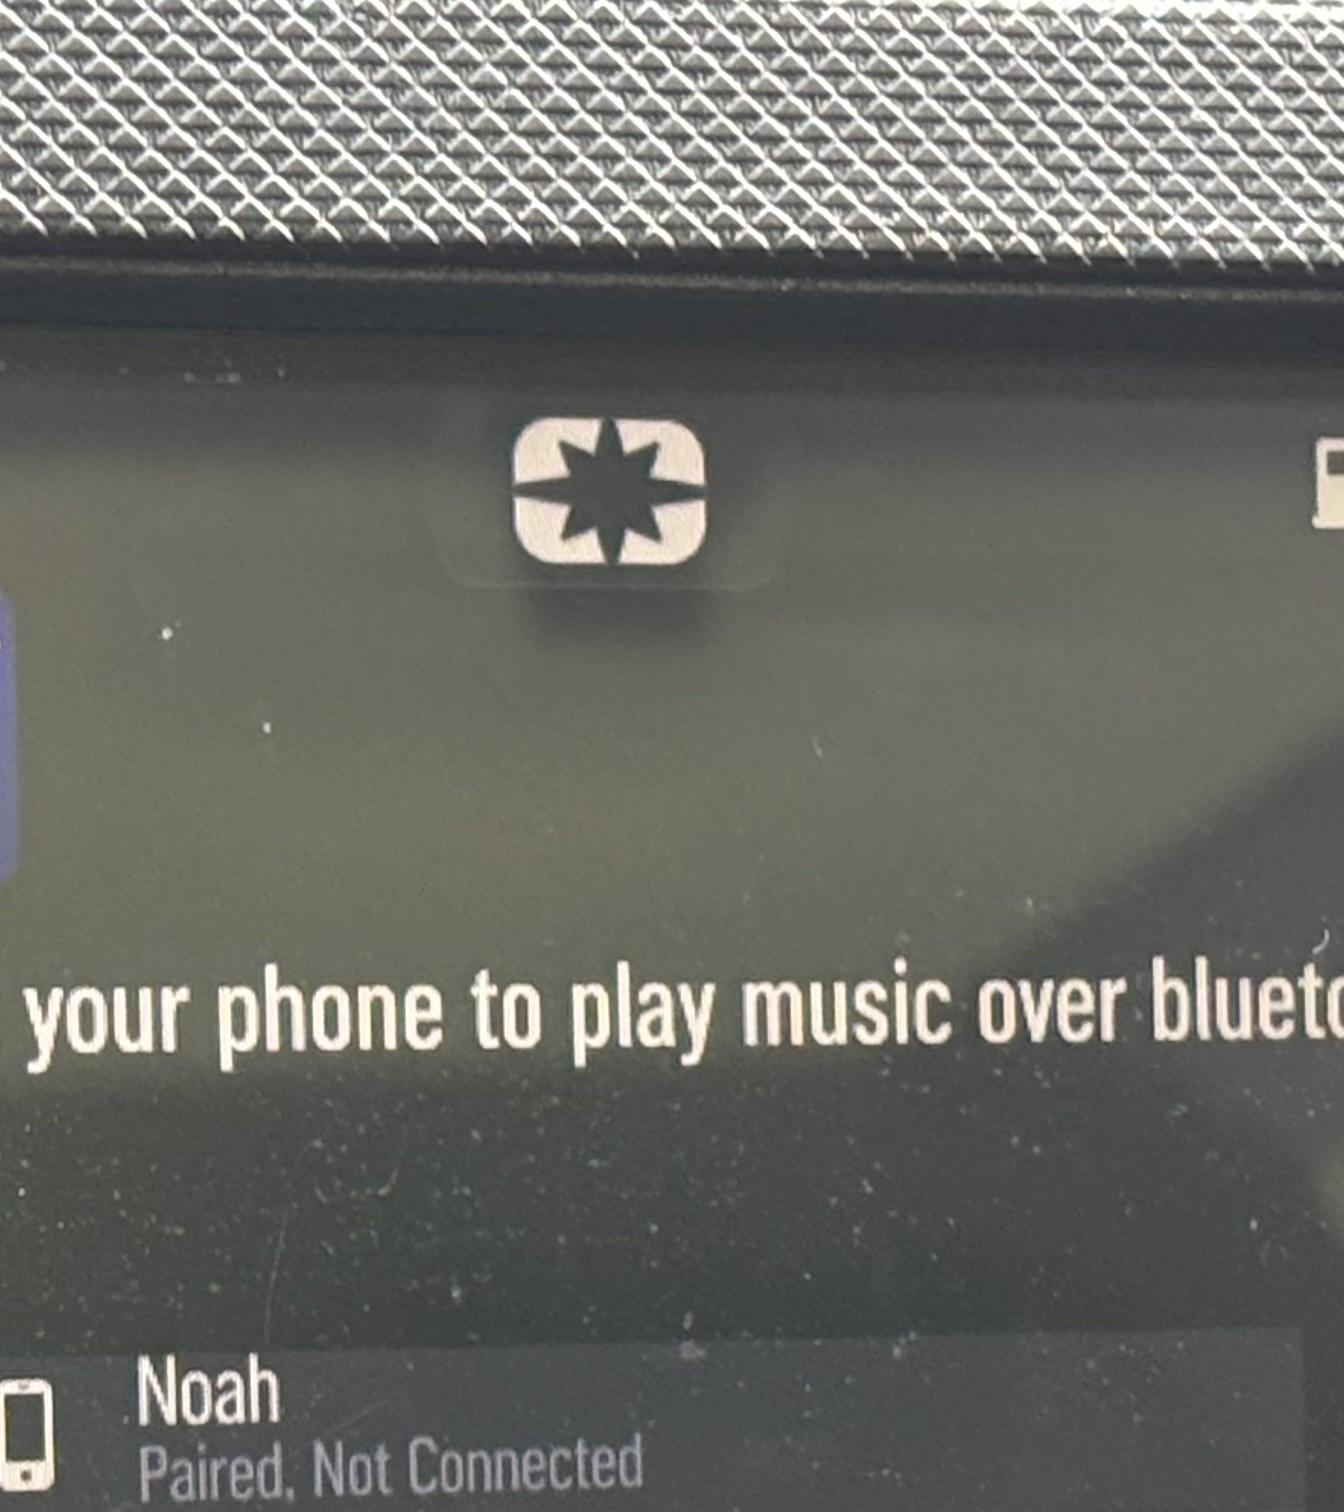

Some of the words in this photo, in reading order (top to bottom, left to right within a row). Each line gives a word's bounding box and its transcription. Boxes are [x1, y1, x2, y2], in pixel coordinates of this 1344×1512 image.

[24, 981, 190, 1073] your
[218, 963, 443, 1071] phone
[470, 969, 542, 1050] to
[570, 960, 716, 1067] play
[743, 957, 952, 1046] music
[978, 976, 1126, 1044] over
[136, 1352, 282, 1426] Noah
[313, 1438, 392, 1497] Not
[408, 1433, 644, 1494] Connected
